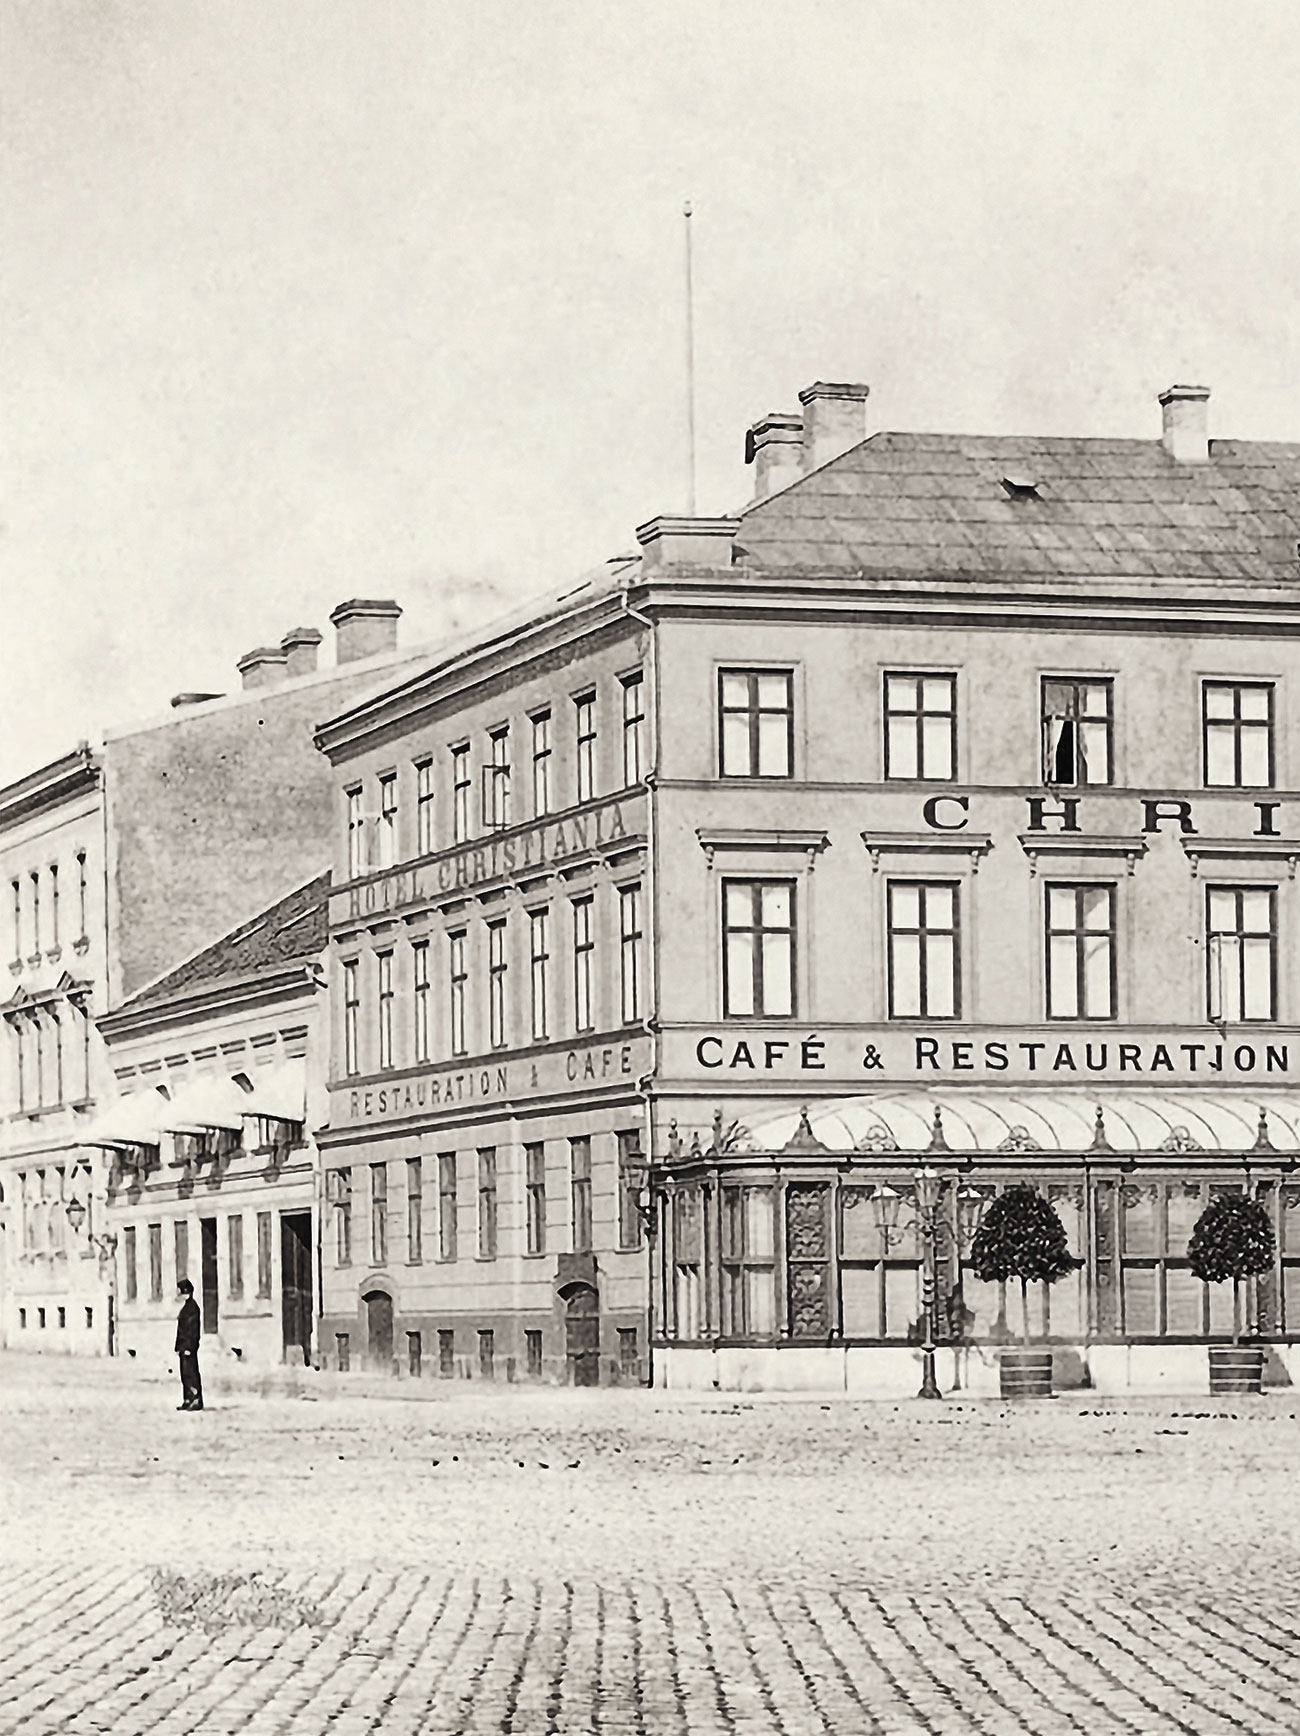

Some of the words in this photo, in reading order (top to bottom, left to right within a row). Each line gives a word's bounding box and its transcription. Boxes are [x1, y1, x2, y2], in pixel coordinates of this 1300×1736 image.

[349, 869, 425, 917] HOTEL
[437, 804, 627, 890] CHRISTIANIA
[696, 1034, 826, 1070] CAFÉ
[862, 1045, 884, 1069] &
[915, 1037, 1290, 1072] RESTAURATION
[350, 1065, 508, 1118] RESTAURATION
